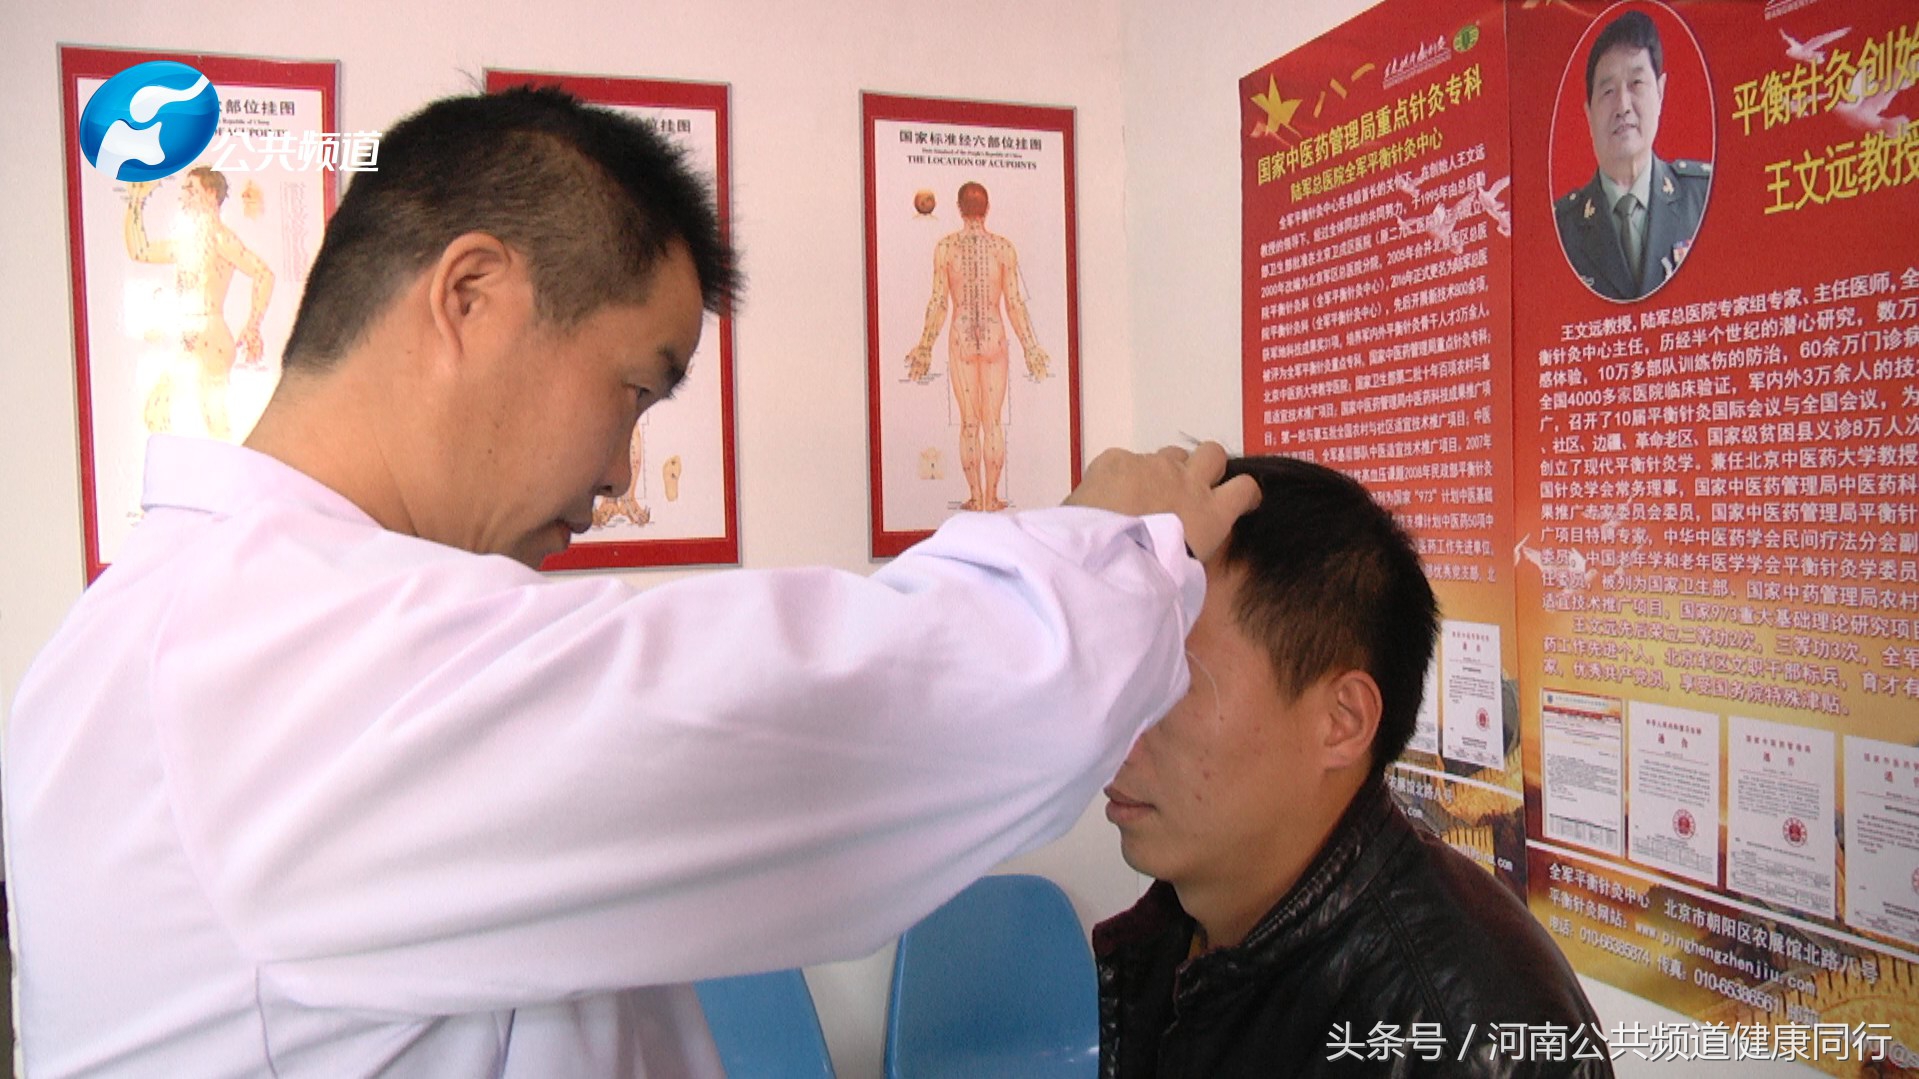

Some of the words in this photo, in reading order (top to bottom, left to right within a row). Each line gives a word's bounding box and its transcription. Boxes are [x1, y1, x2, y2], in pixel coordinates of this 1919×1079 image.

[217, 98, 295, 116] 部位挂图
[1258, 63, 1482, 186] 国家中医药管理局重点针灸专科
[899, 130, 1042, 151] 国家标准经穴部位挂图
[907, 155, 925, 164] THE
[927, 155, 973, 167] LOCATION
[975, 158, 987, 167] OF
[988, 158, 1037, 170] ACUPOINTS
[1291, 127, 1443, 202] 陆军总医院全军平衡针灸中心
[1764, 119, 1919, 215] 王文远教授
[1540, 355, 1919, 411] 全国4000多家医院临床验证，军内外3万余人的技
